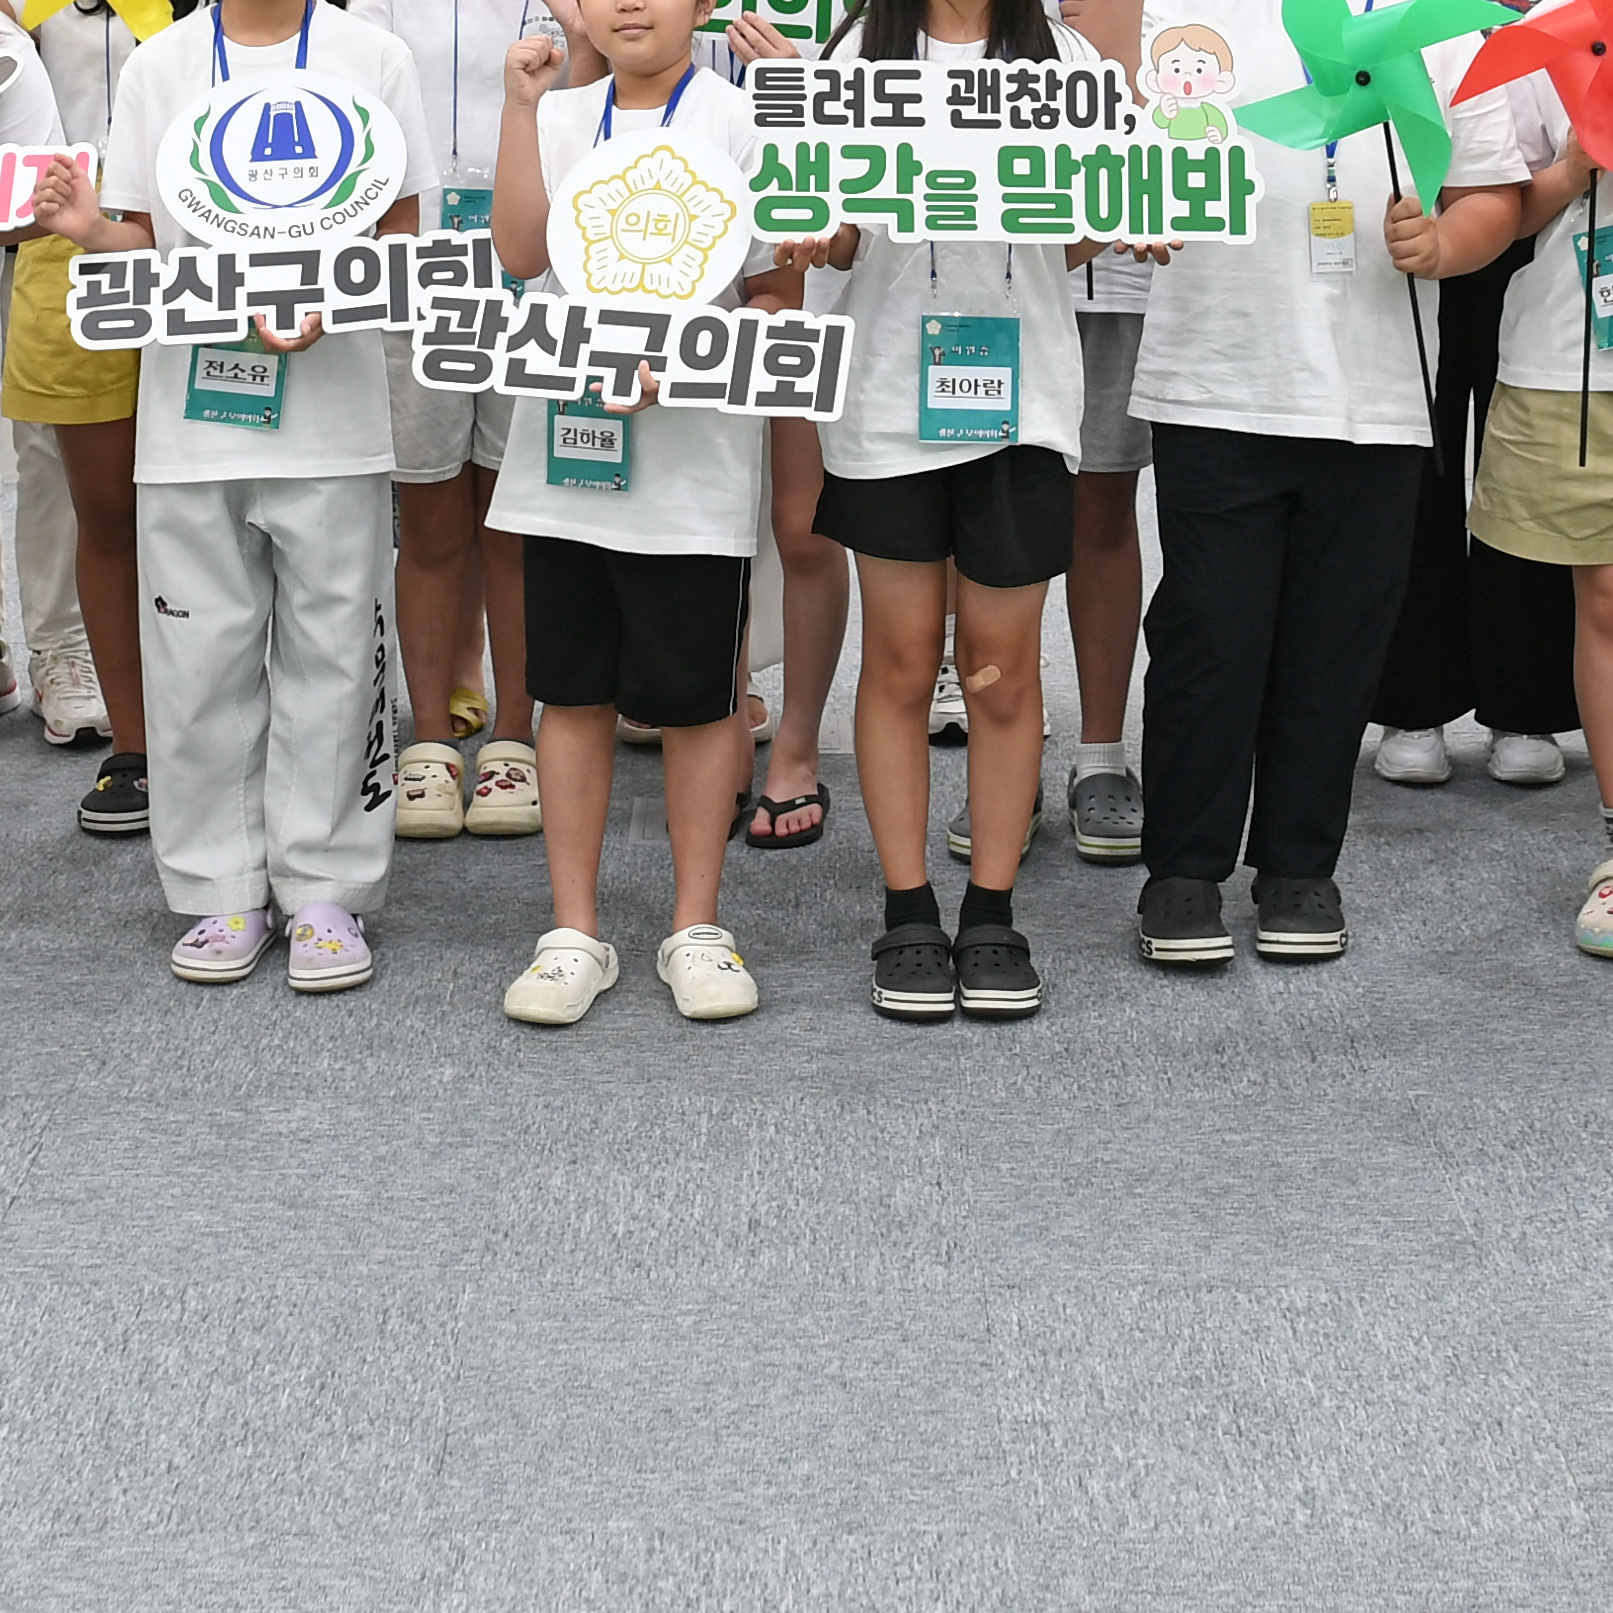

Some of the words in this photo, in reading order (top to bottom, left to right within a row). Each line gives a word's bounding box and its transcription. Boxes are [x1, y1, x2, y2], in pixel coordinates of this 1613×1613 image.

[751, 66, 927, 129] 틀려도
[945, 67, 1138, 136] 괜찮아,
[247, 165, 319, 182] 광산구의회
[748, 141, 980, 235] 생각을
[996, 142, 1256, 237] 말해봐
[177, 187, 316, 240] GWANGSAN-GU
[319, 175, 391, 232] COUNCIL
[620, 210, 681, 244] 의회
[76, 236, 494, 342] 광산구의회
[202, 359, 270, 383] 전소유
[421, 295, 847, 413] 광산구의회
[934, 377, 1005, 396] 최아람
